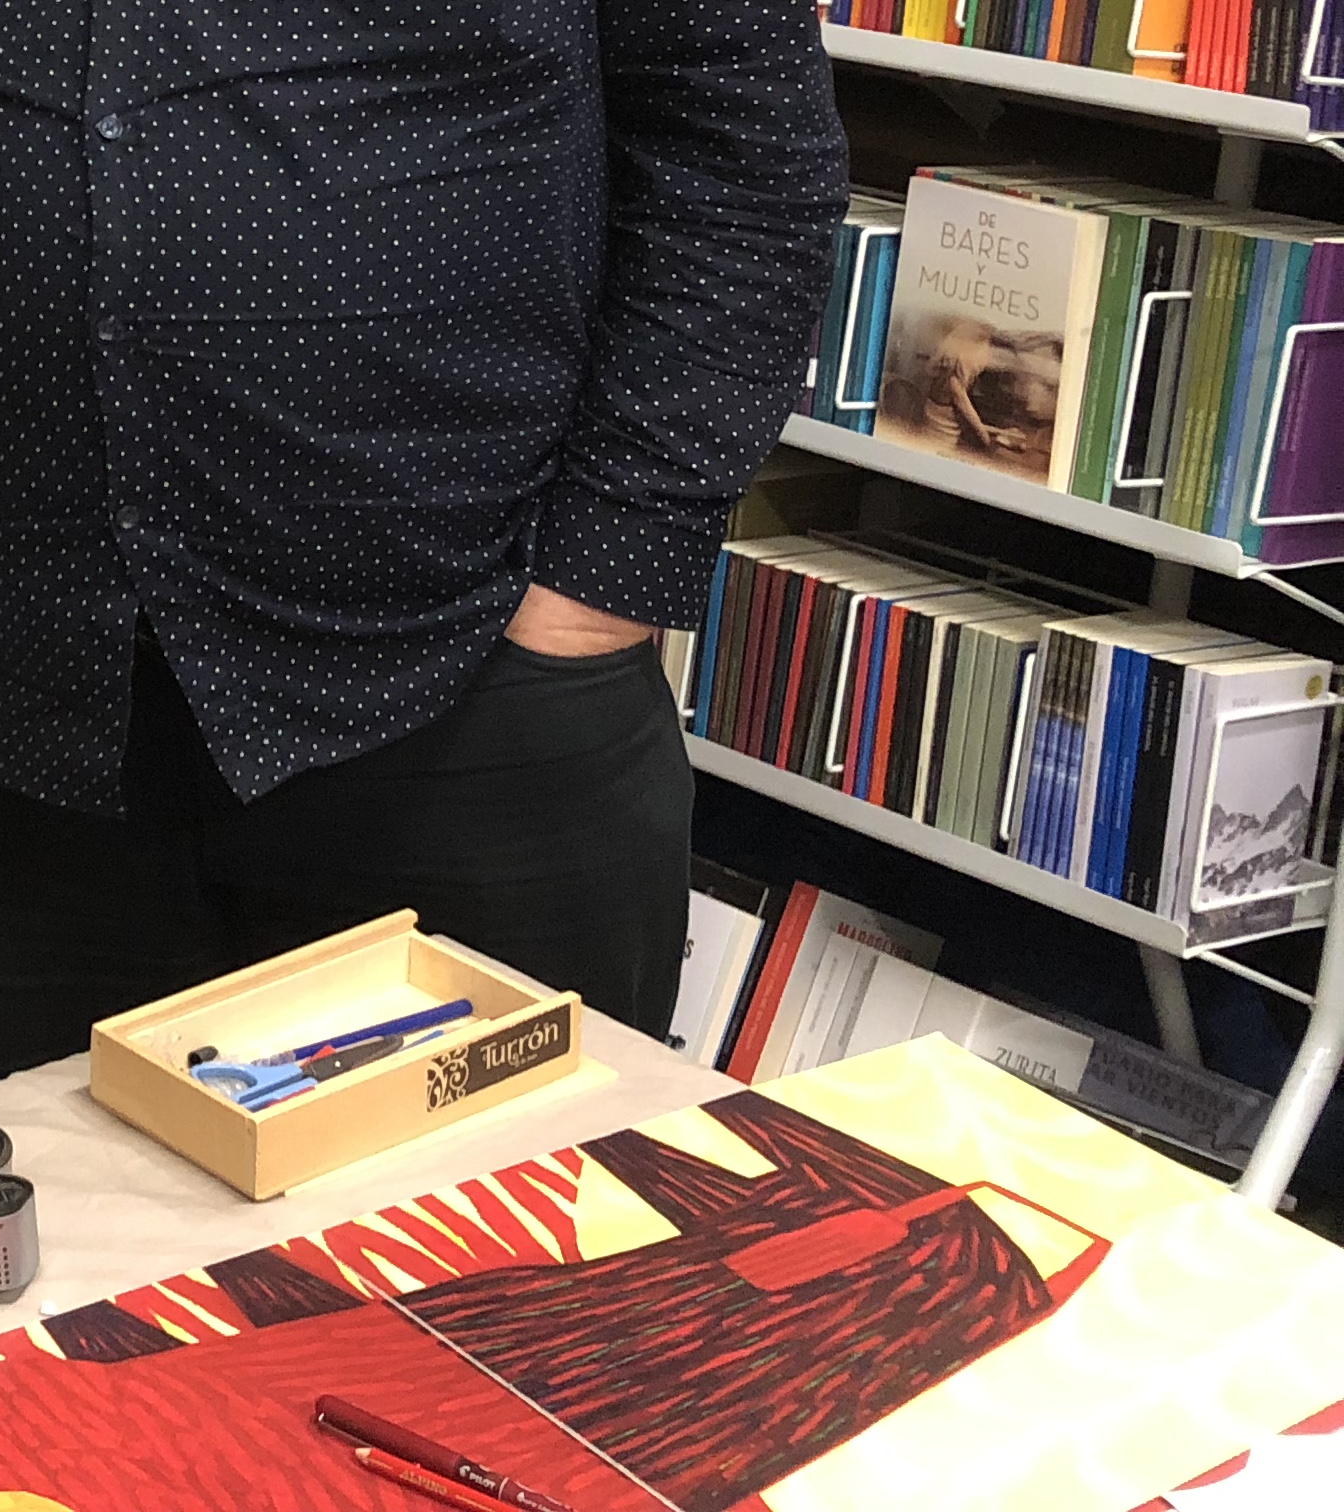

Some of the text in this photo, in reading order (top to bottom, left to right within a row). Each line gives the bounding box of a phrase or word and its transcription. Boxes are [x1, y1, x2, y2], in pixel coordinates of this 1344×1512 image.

[978, 211, 998, 229] DE
[939, 221, 1030, 270] BARES
[976, 263, 987, 276] Y
[918, 265, 1040, 322] MUJERES
[479, 1020, 560, 1071] Turrón
[993, 1045, 1060, 1085] ZURITA
[399, 1469, 448, 1496] ALPINO
[469, 1471, 497, 1491] PILOT
